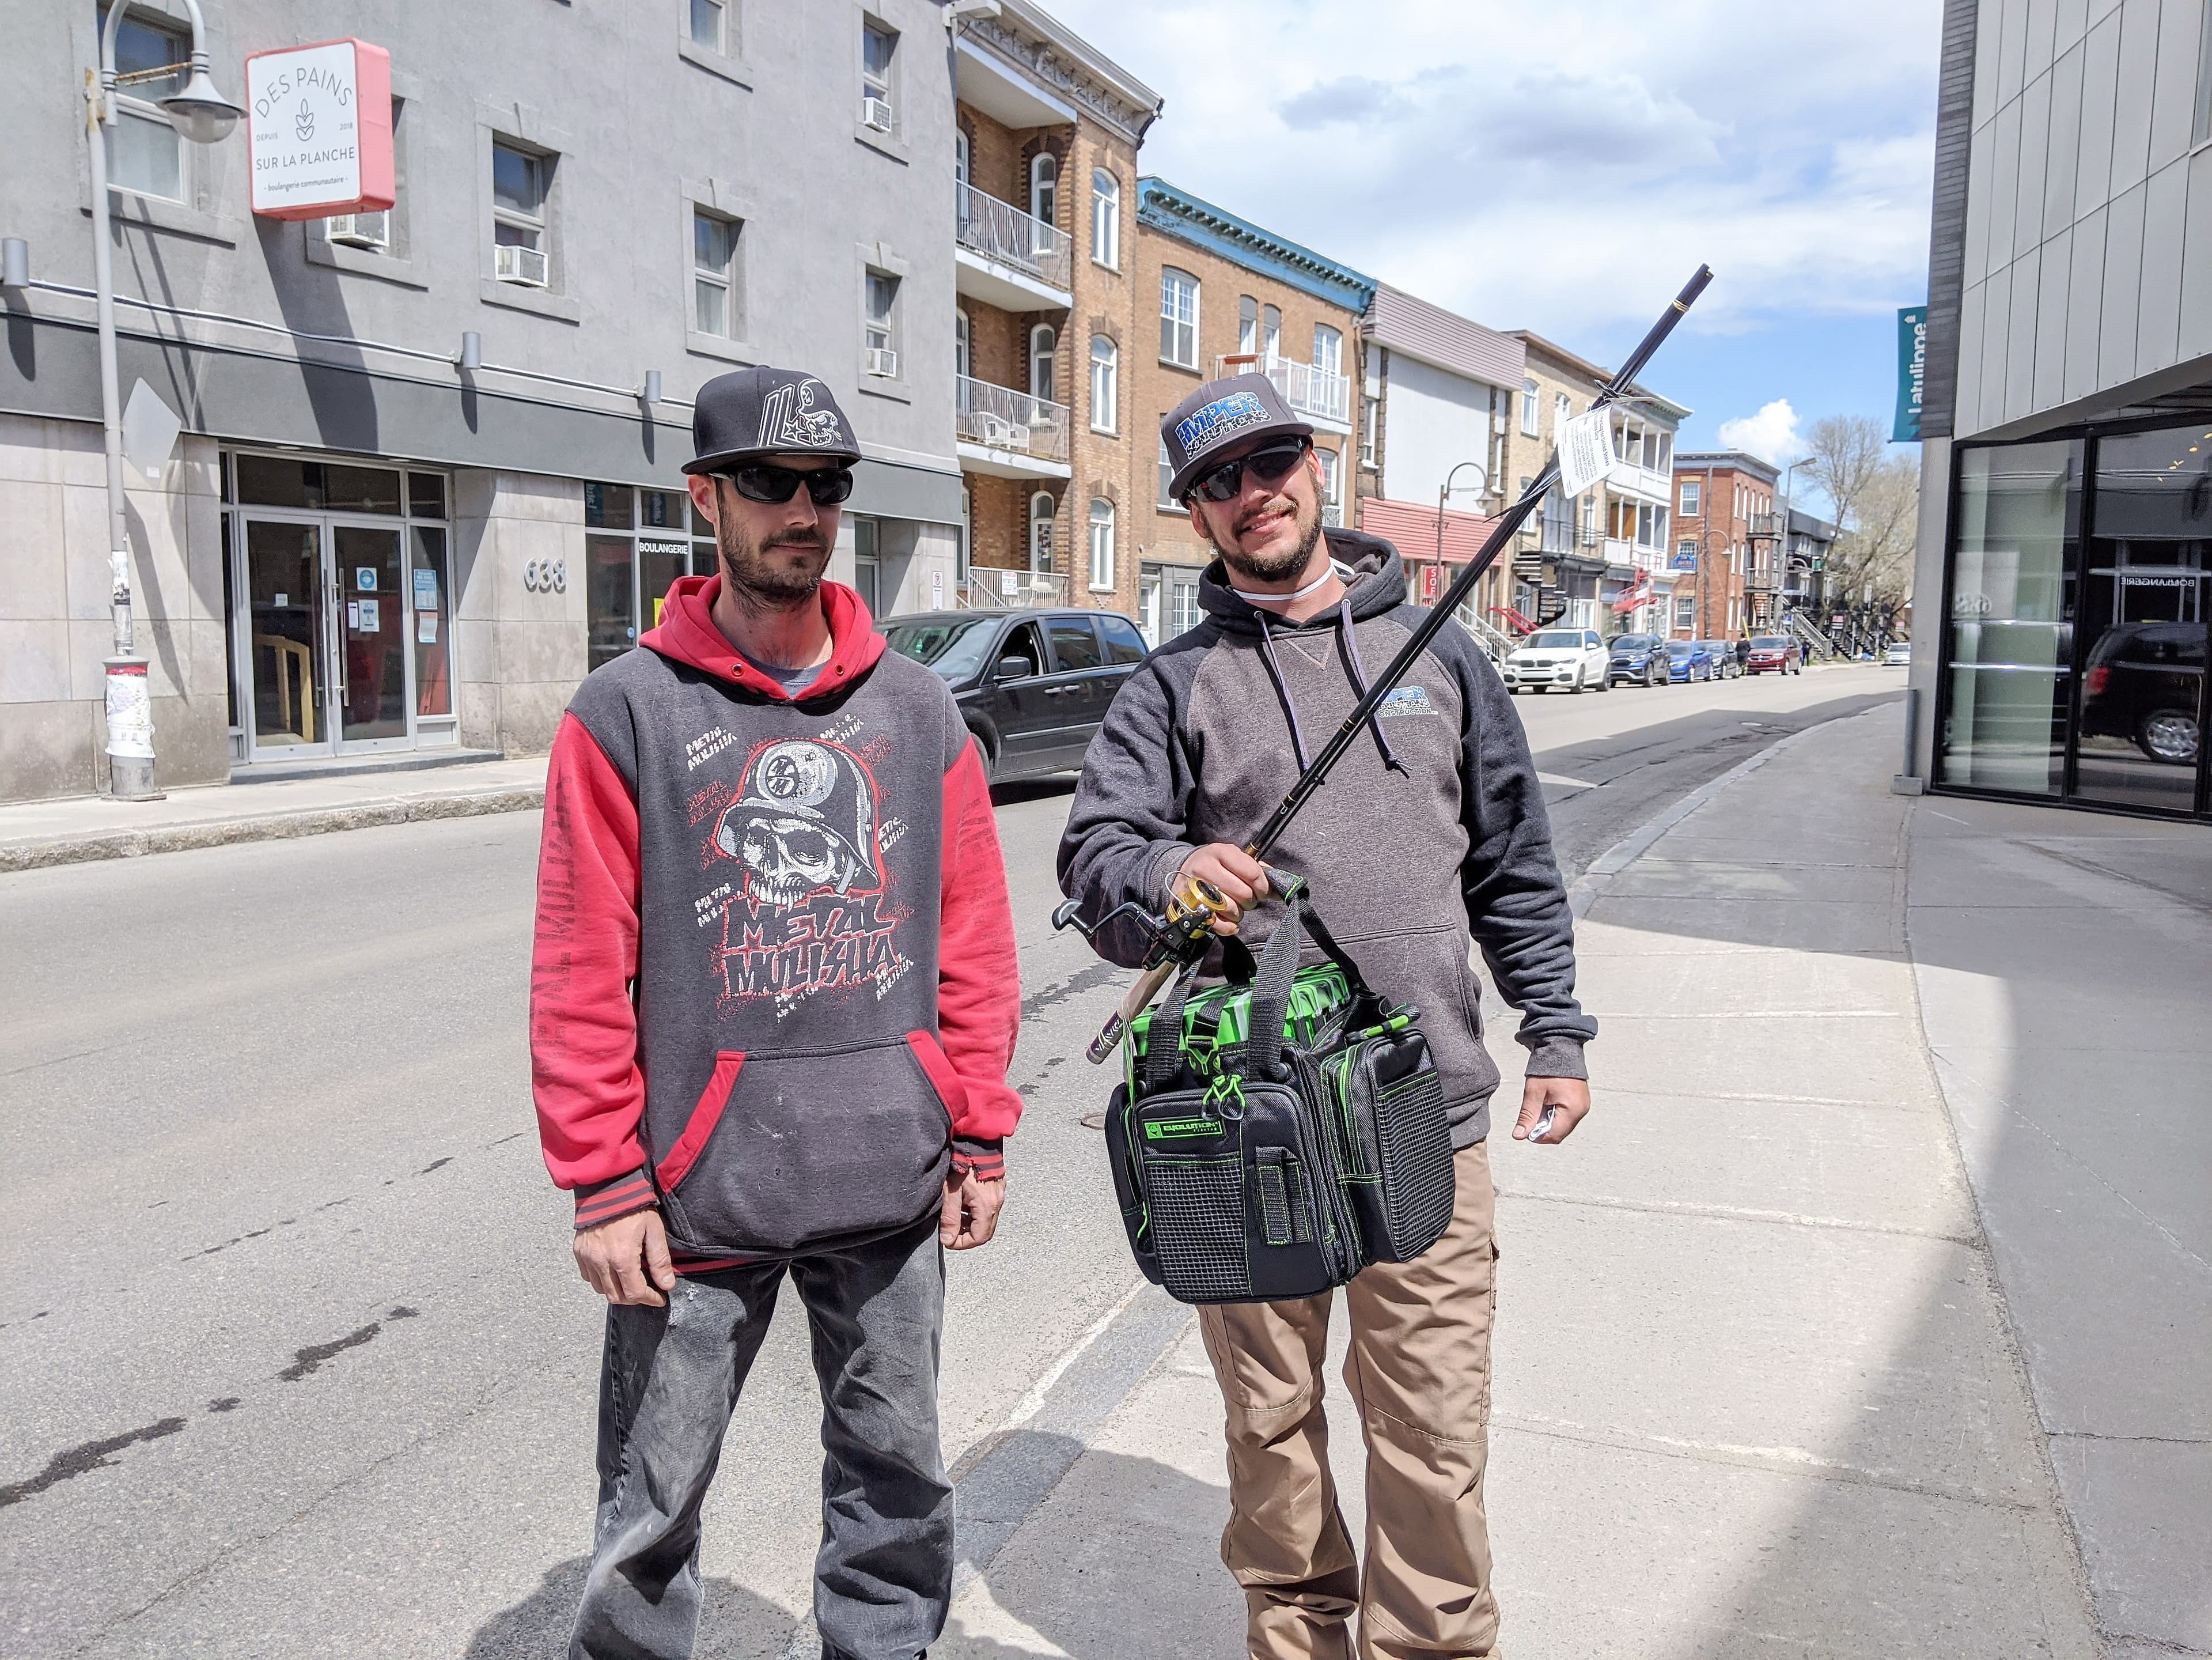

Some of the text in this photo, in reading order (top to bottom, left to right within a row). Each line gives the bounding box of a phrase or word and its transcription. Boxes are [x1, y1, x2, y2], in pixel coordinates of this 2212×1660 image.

[255, 66, 352, 118] DES PAINS
[256, 122, 353, 142] DEPUIS 2018
[256, 147, 355, 171] SUR LA PLANCHE
[268, 181, 300, 192] boulangerie
[639, 542, 688, 555] BOULANGERIE
[524, 558, 566, 591] 638
[1378, 708, 1431, 718] ONSTRUCTION
[724, 893, 897, 949] METAL
[1163, 1122, 1216, 1132] EVOLUTION
